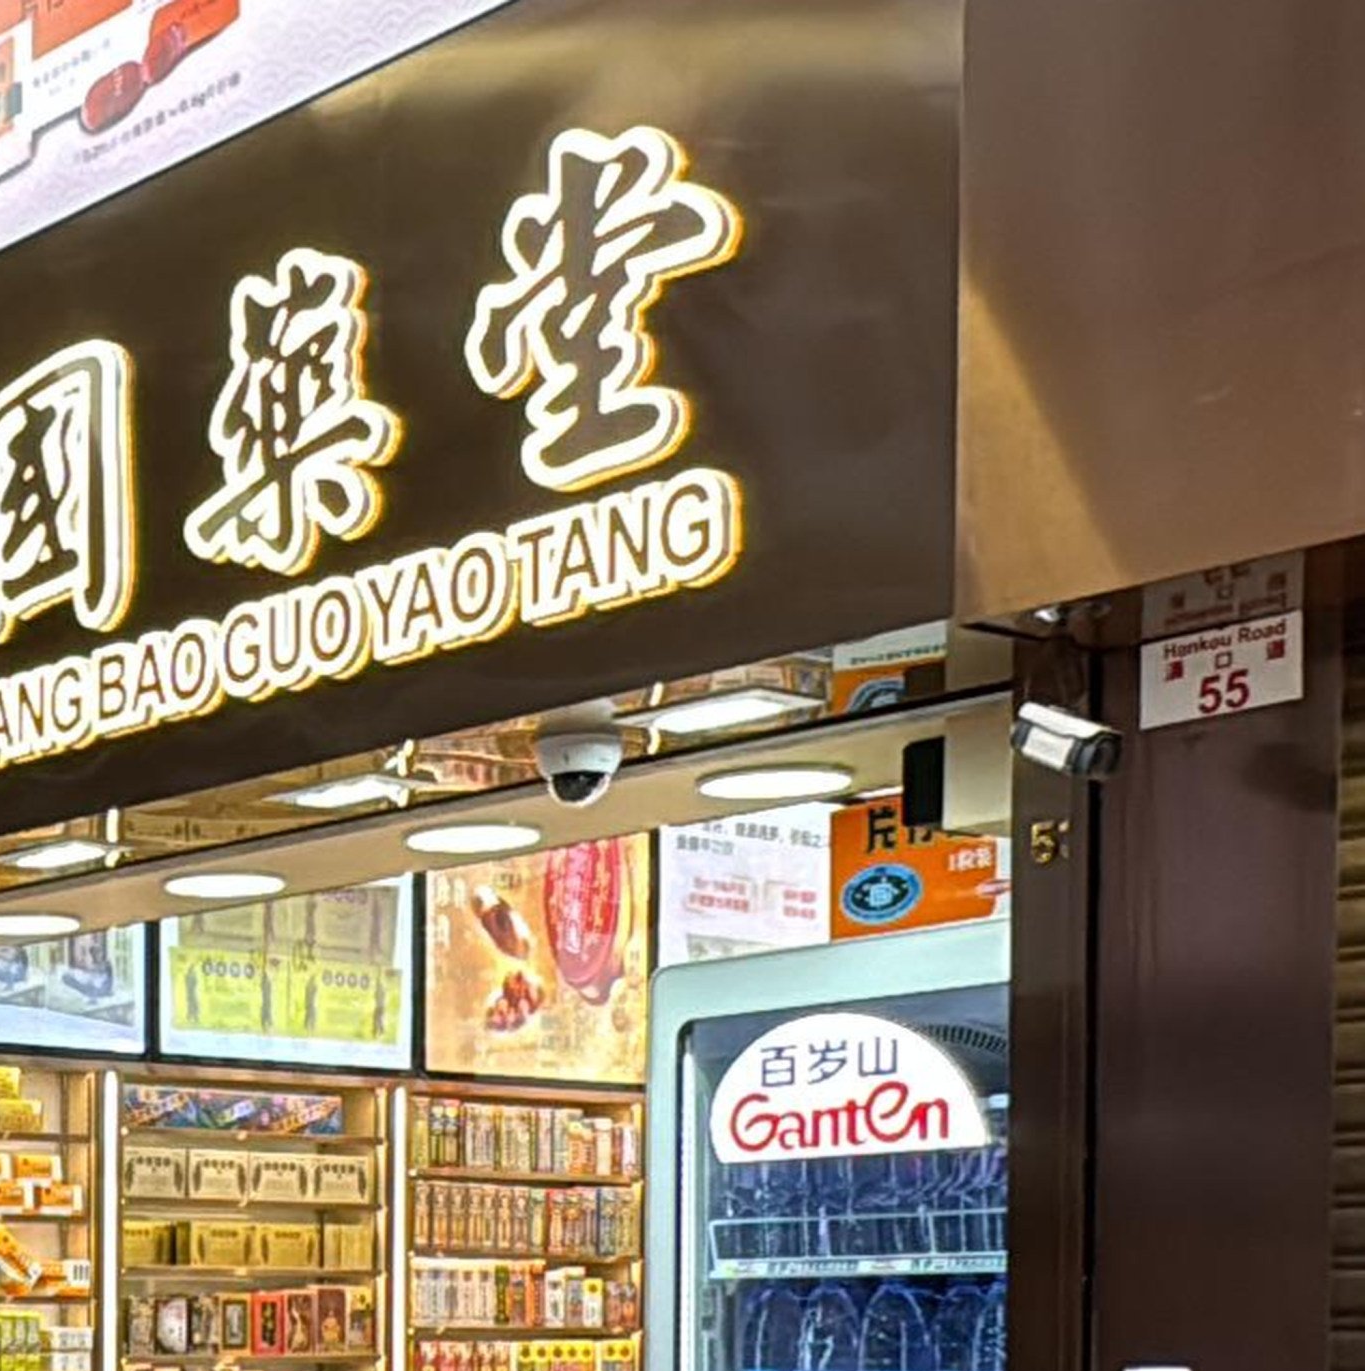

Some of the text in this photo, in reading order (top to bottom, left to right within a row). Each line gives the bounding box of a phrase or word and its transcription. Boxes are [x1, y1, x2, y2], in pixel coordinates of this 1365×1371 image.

[96, 627, 212, 728] BAO
[221, 578, 354, 696] GUO
[364, 532, 502, 664] YAO
[518, 480, 728, 614] TANG
[1163, 618, 1287, 660] Hankou Road
[1199, 668, 1250, 715] 55
[760, 1036, 899, 1088] 百岁山
